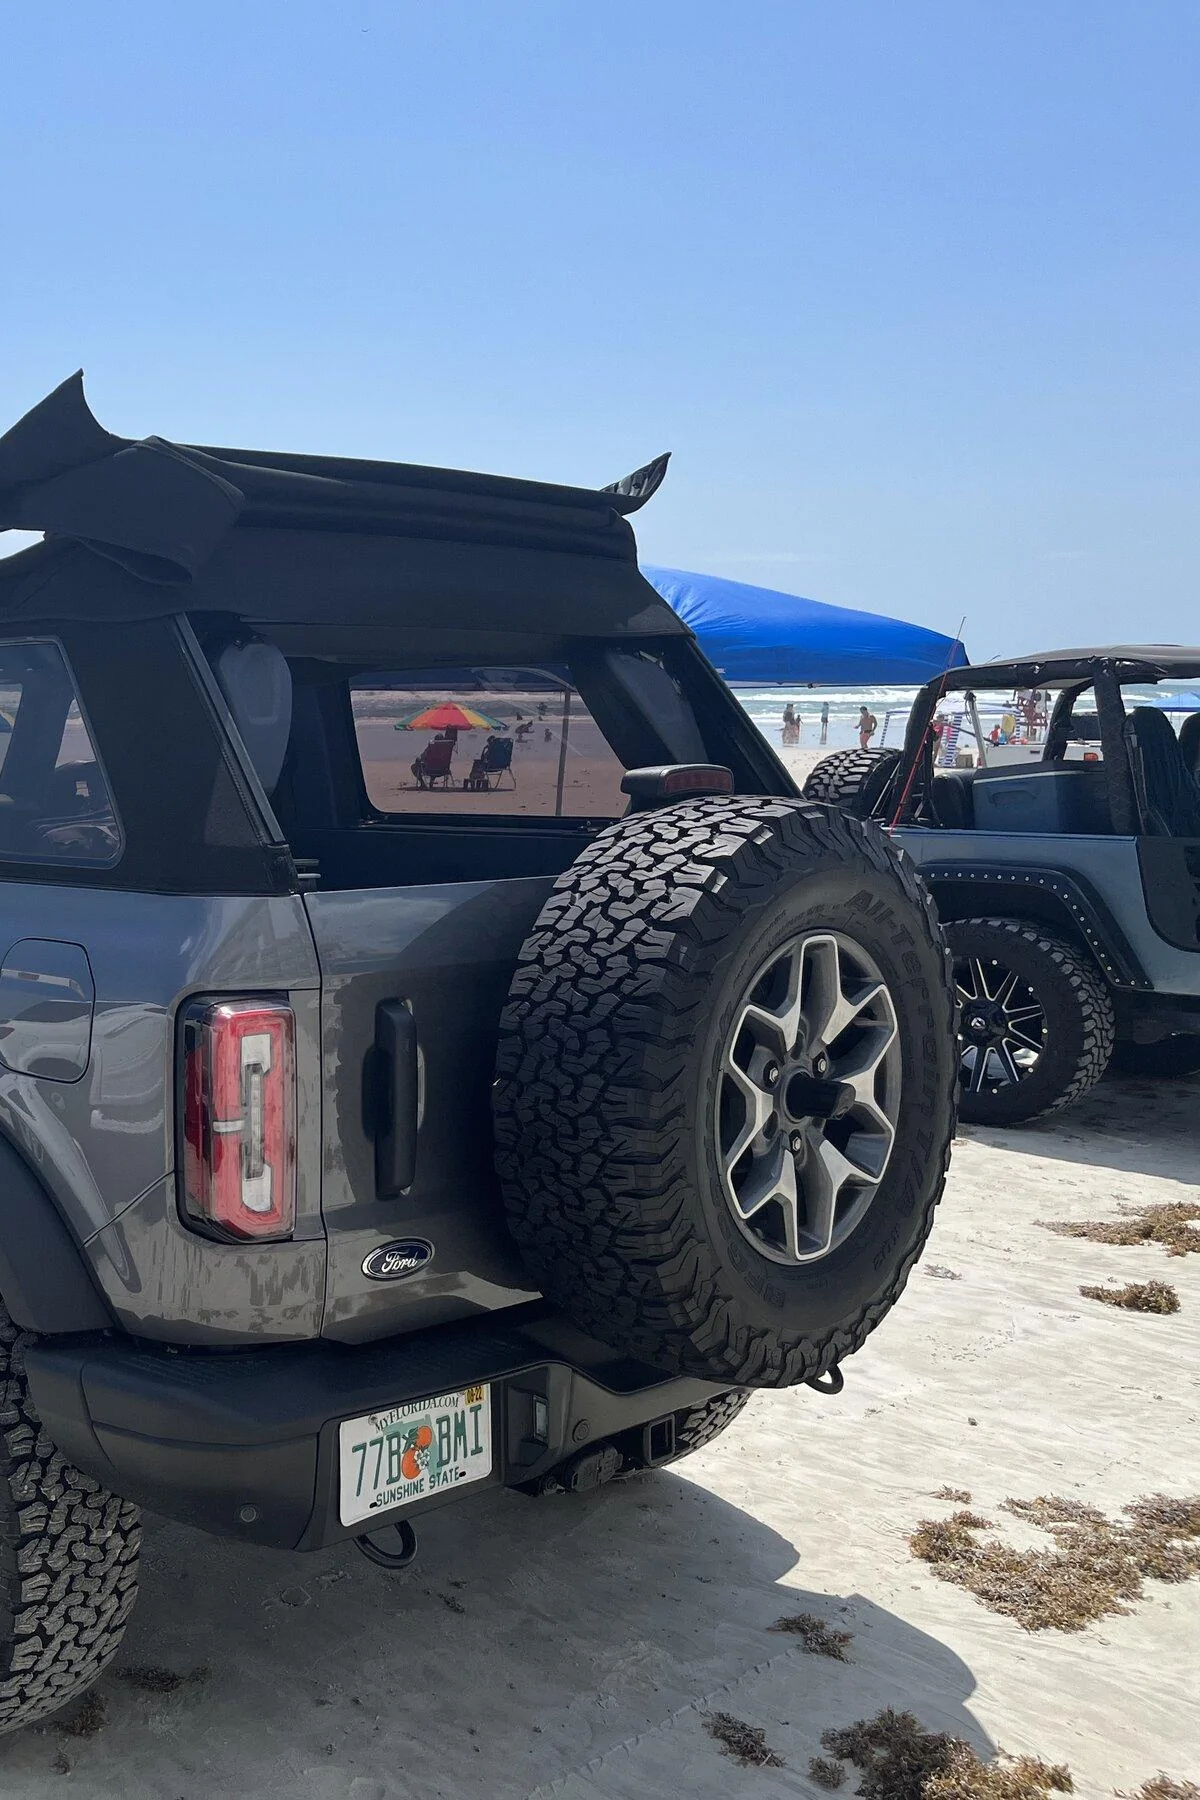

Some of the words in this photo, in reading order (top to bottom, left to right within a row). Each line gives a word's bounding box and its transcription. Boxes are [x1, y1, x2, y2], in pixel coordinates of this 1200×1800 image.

[381, 1251, 418, 1273] Ford
[352, 1431, 402, 1496] 77B
[435, 1404, 484, 1468] BMI
[375, 1479, 425, 1508] SUNSHINE
[428, 1466, 460, 1488] STATE
